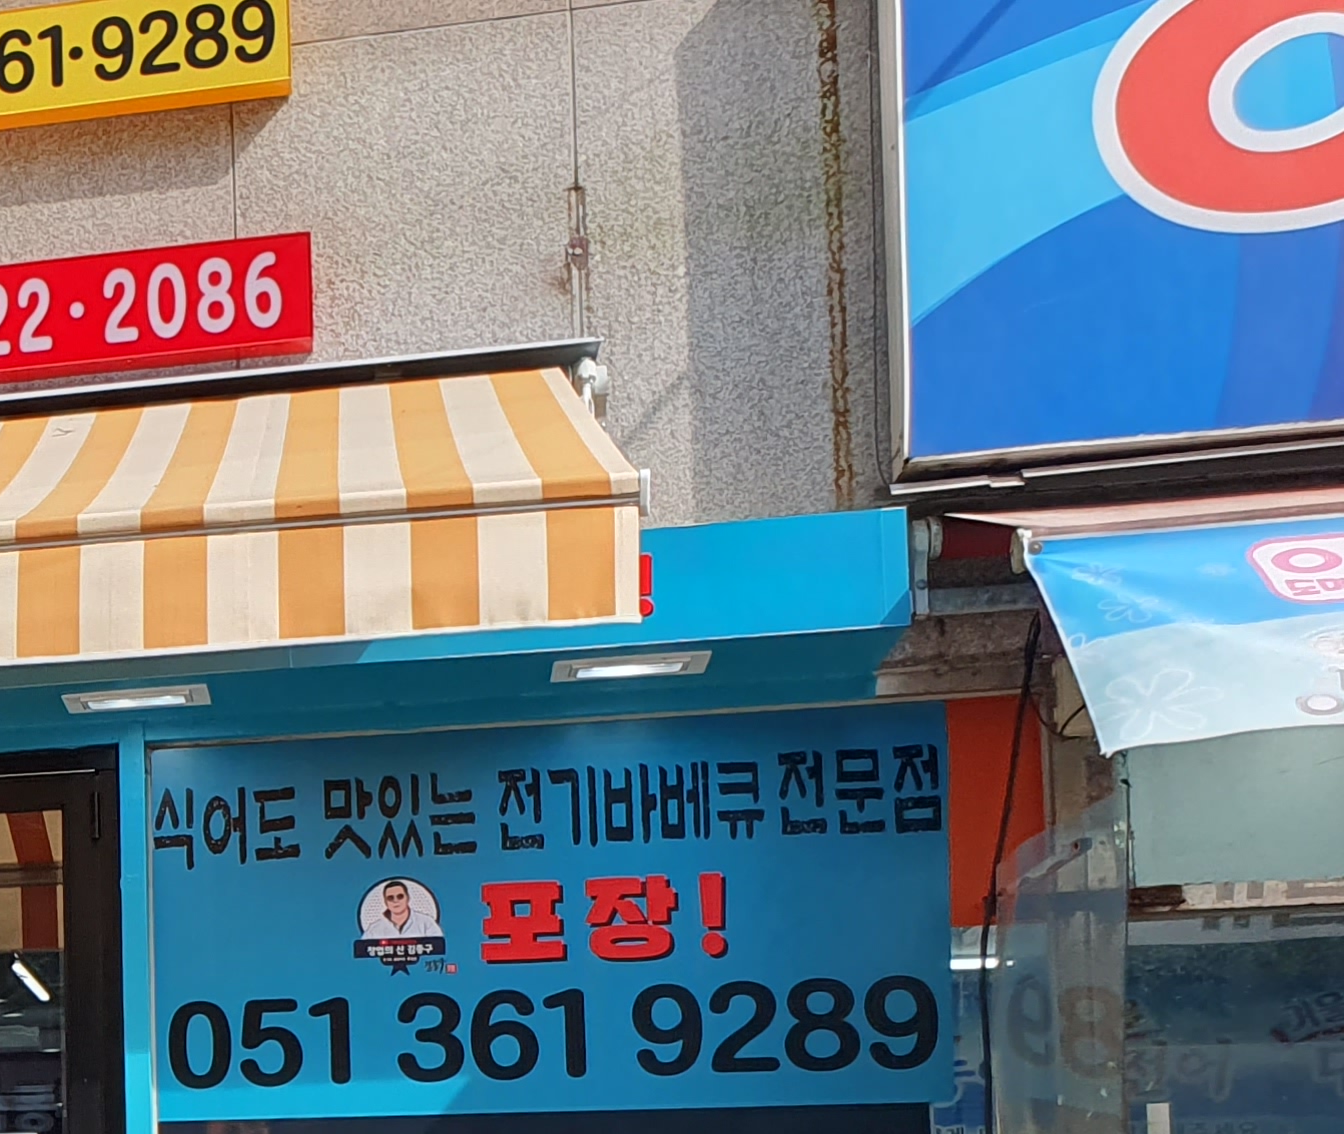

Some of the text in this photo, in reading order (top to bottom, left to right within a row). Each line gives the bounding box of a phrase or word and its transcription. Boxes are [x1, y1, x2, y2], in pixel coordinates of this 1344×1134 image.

[153, 742, 943, 870] 식어도 맛있는 전기바베큐 전문점
[479, 870, 729, 963] 포장!
[166, 996, 353, 1091] 051
[395, 986, 588, 1084] 361
[631, 973, 940, 1077] 9289
